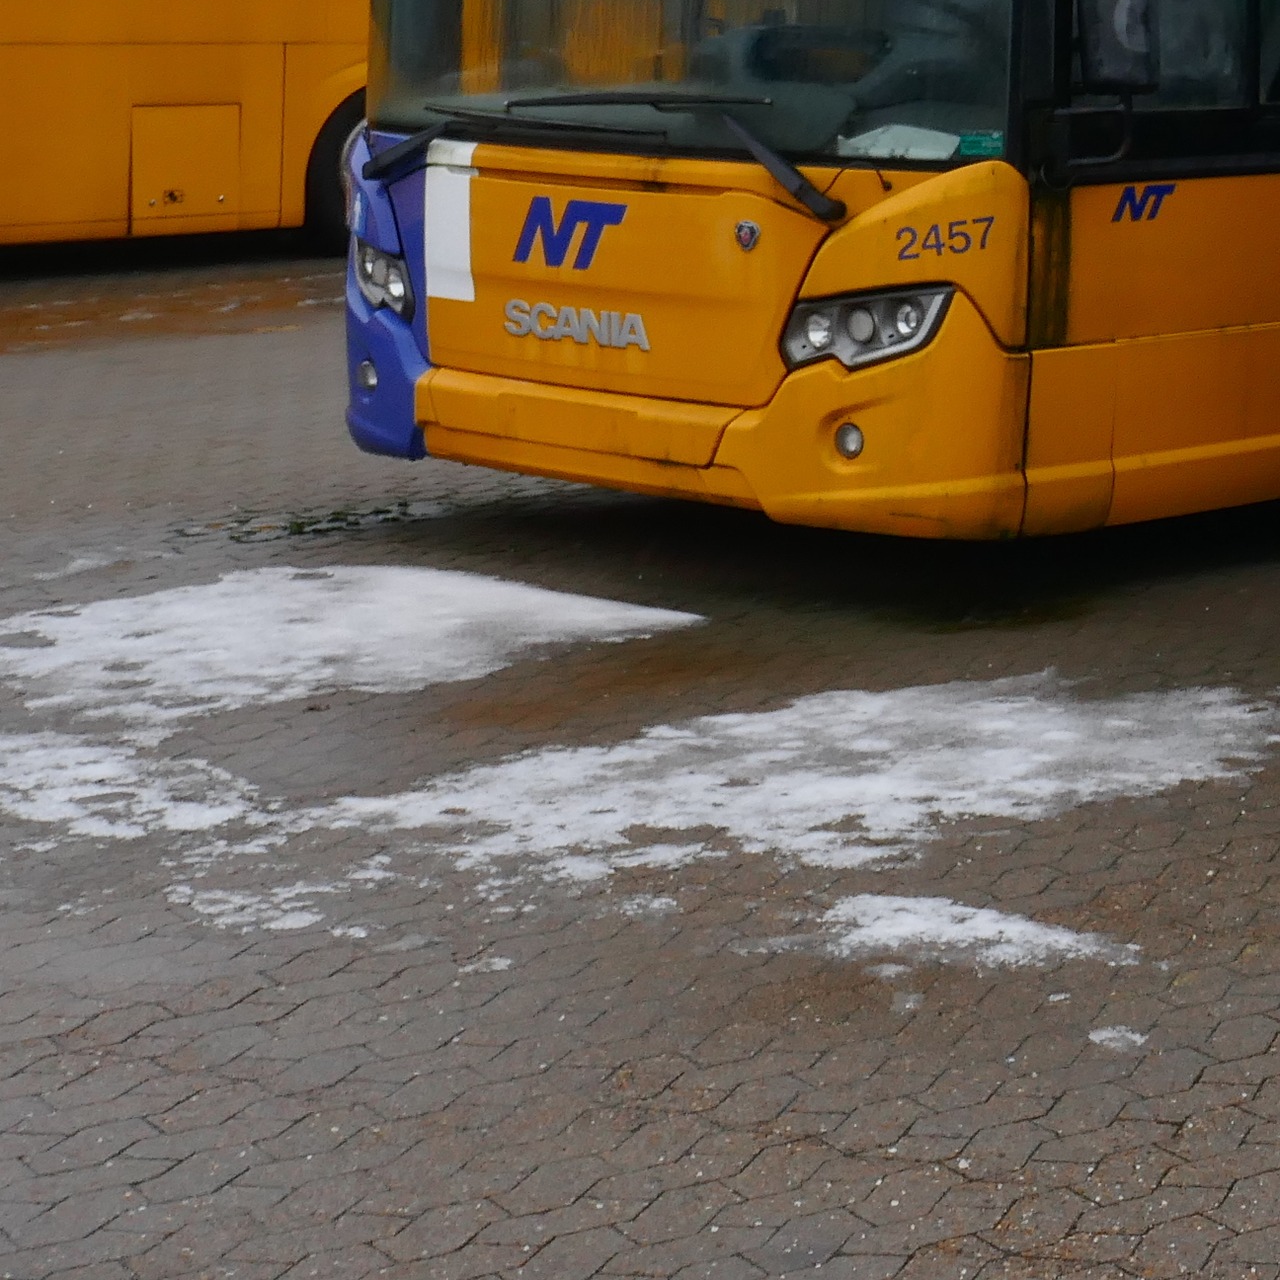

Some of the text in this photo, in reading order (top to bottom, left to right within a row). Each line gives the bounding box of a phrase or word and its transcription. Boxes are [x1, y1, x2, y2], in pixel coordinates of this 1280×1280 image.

[1111, 184, 1177, 223] NT
[511, 196, 627, 271] NT
[895, 216, 996, 262] 2457
[503, 298, 651, 352] SCANIA
